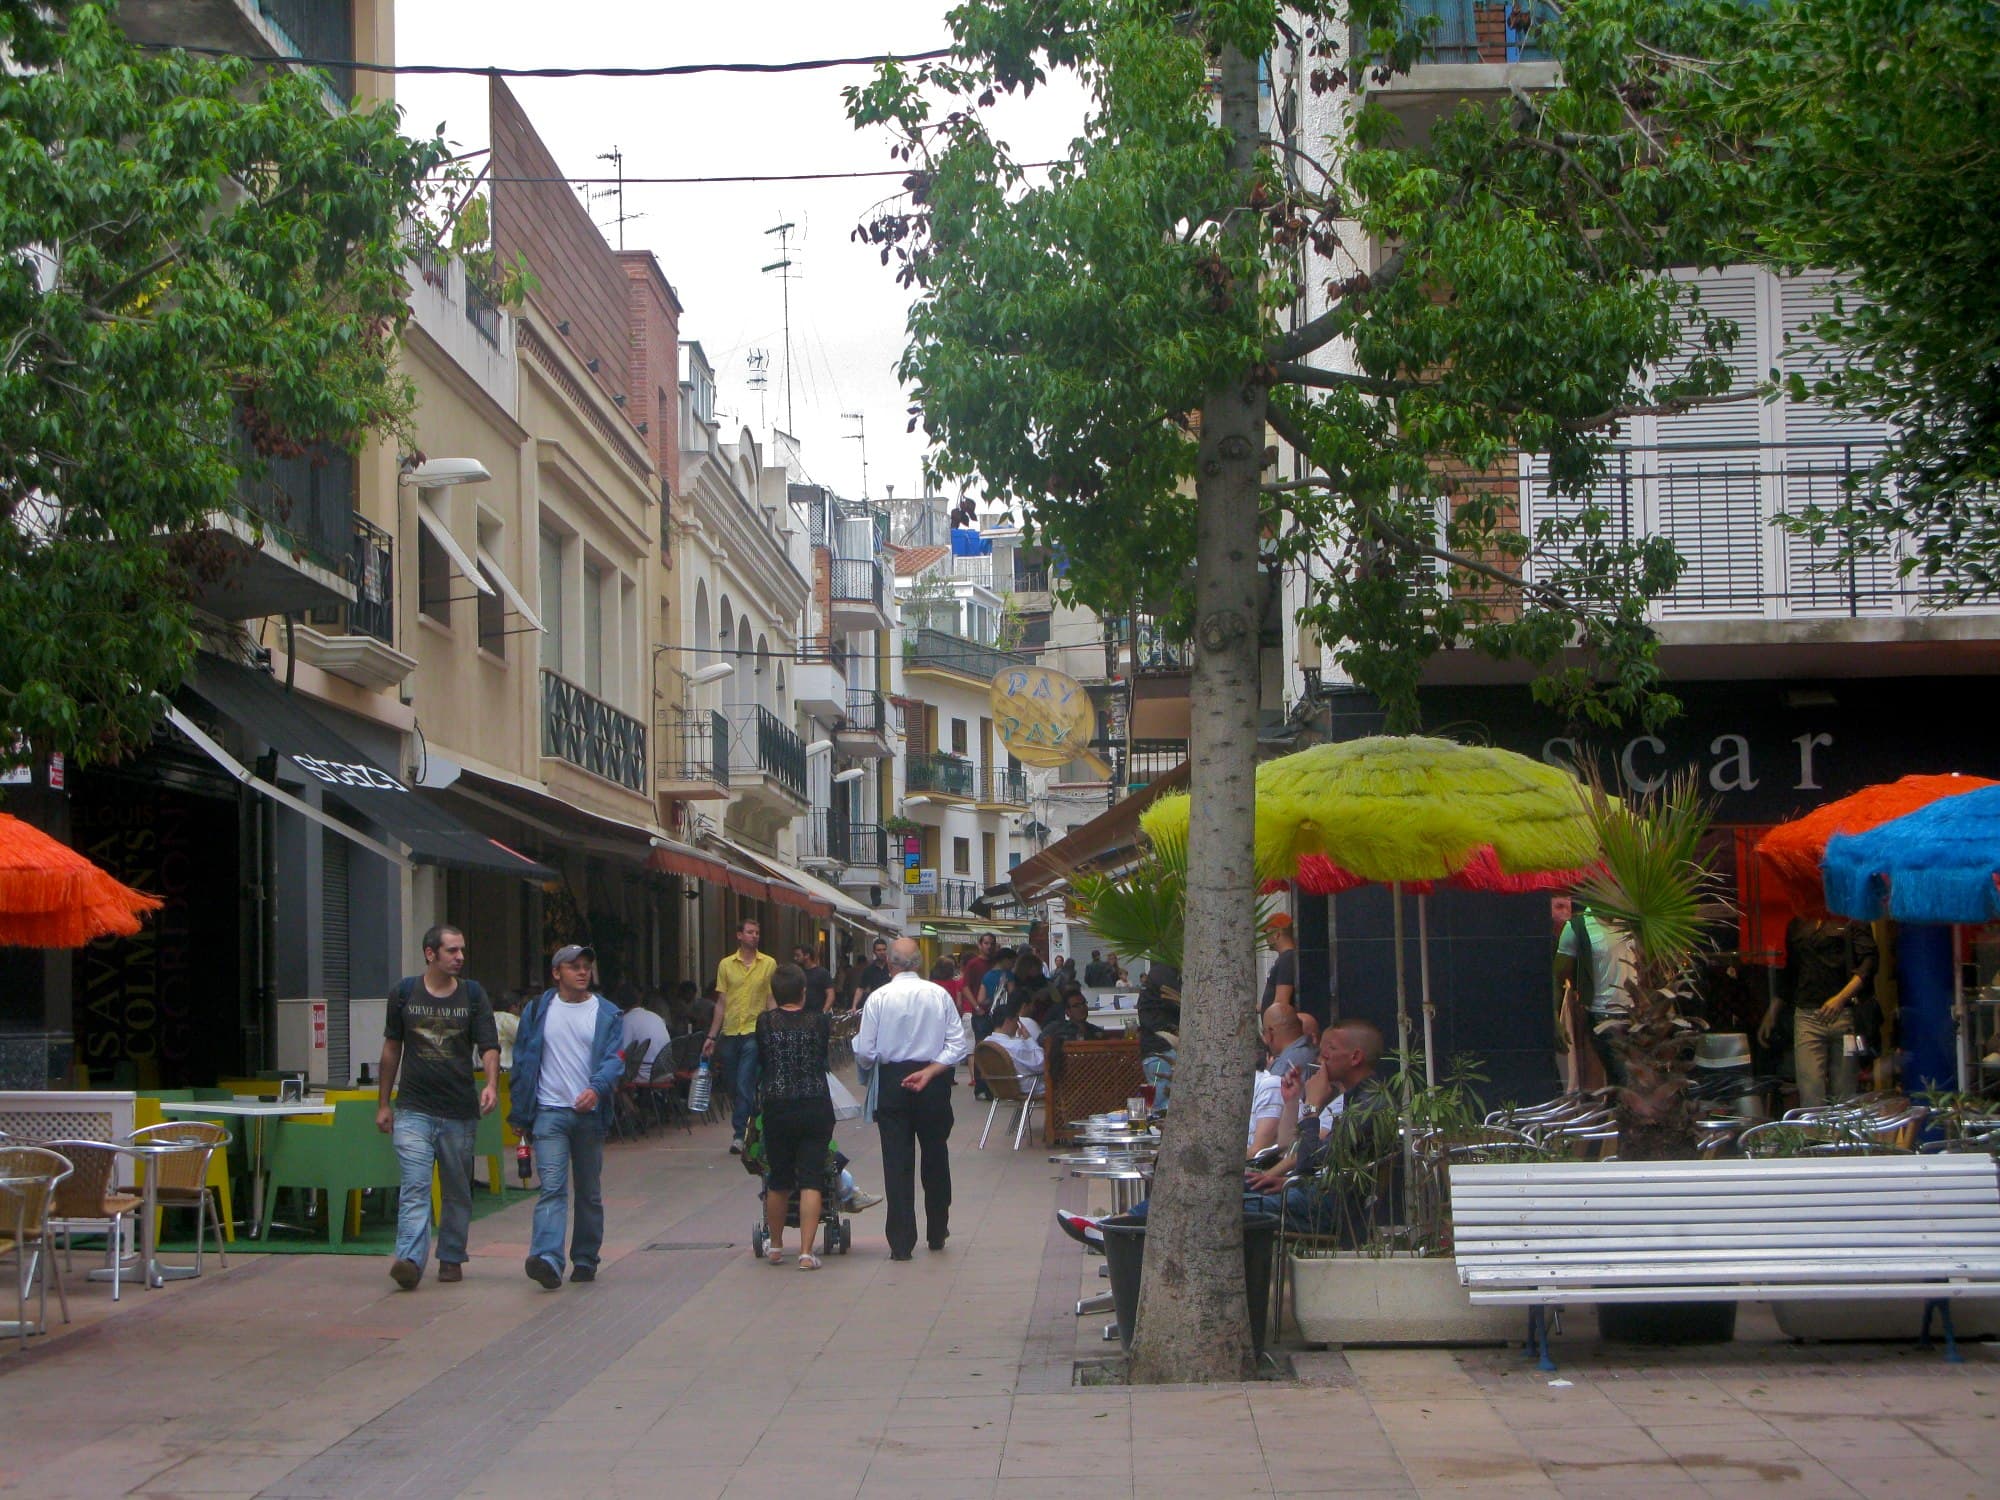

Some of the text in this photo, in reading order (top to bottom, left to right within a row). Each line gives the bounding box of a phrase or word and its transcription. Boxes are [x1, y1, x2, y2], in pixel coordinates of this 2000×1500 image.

[1007, 671, 1076, 705] PAY
[1003, 716, 1073, 745] PAY
[125, 827, 157, 1058] COLMN'S
[437, 1007, 450, 1016] AND
